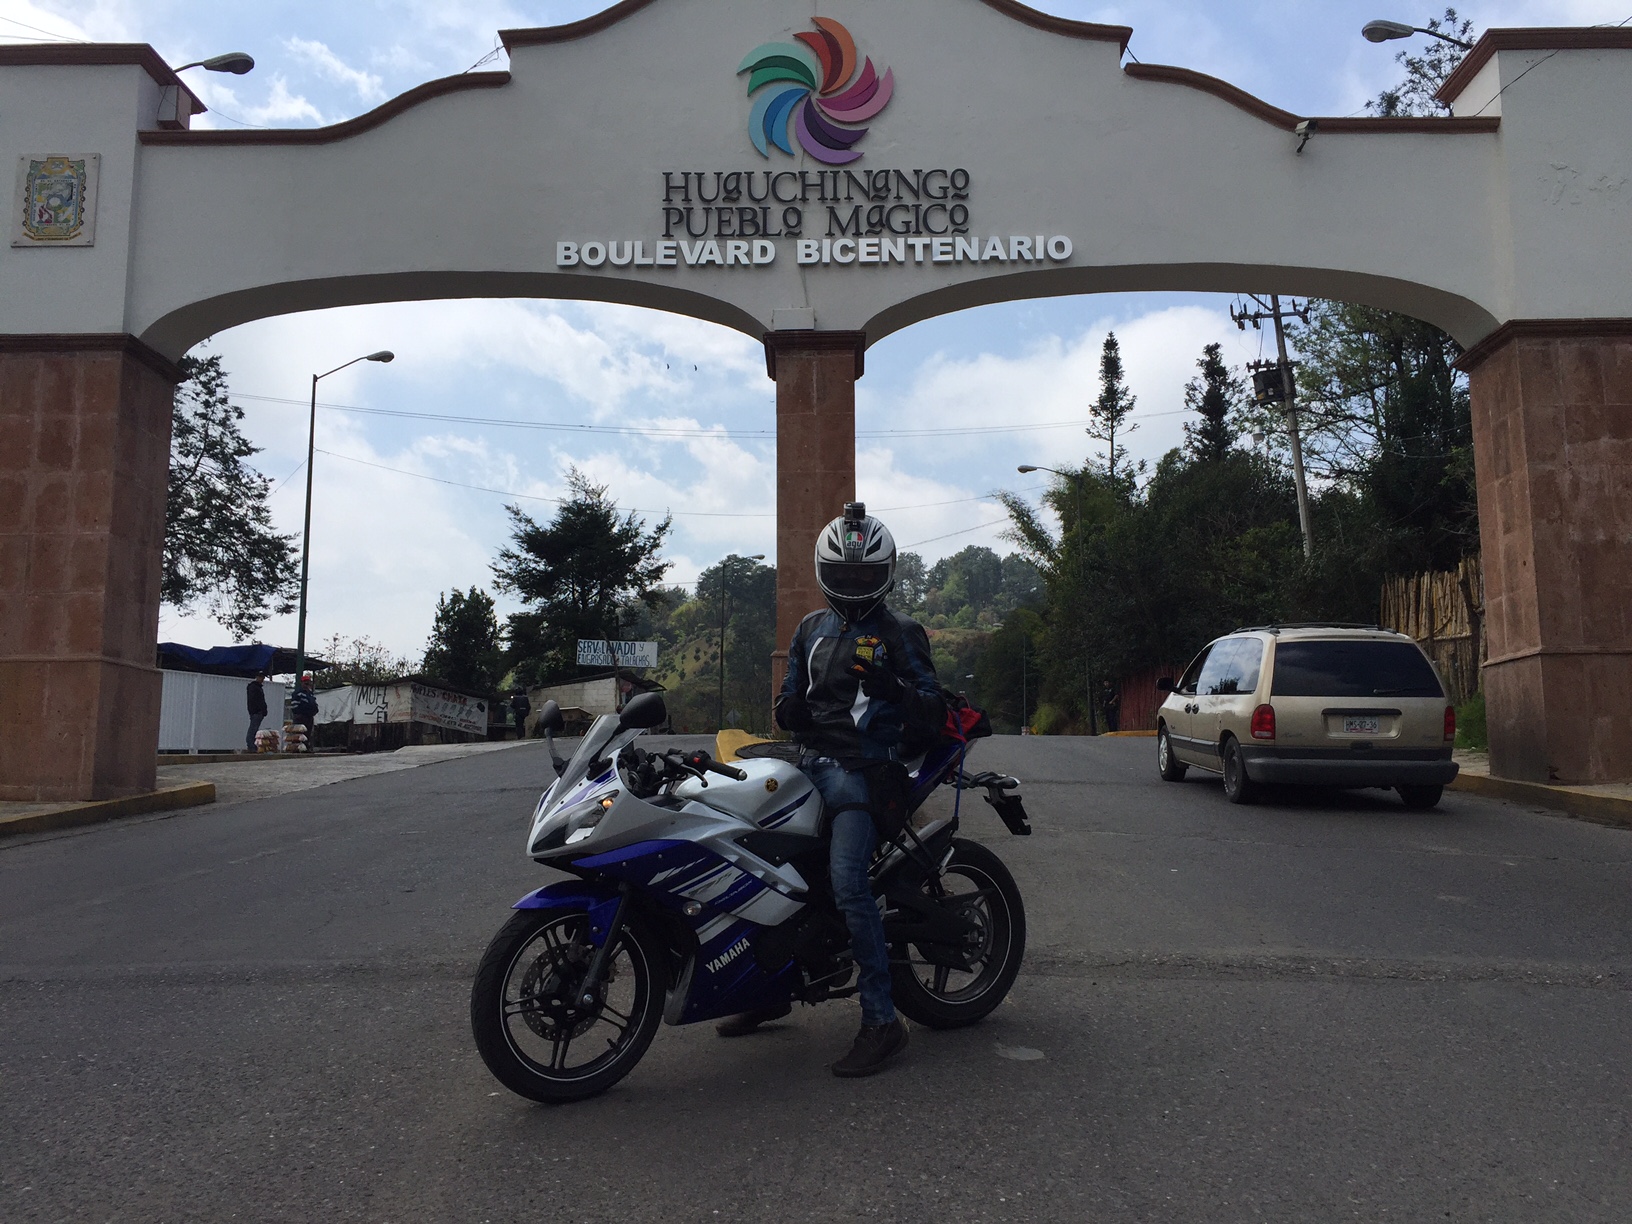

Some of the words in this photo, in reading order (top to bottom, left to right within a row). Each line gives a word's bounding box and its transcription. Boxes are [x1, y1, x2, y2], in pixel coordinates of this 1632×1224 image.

[556, 239, 776, 268] BOULEVARD
[797, 235, 1073, 265] BICENTENARIO
[601, 641, 636, 656] LAVADO
[705, 937, 751, 974] YAMAHA
